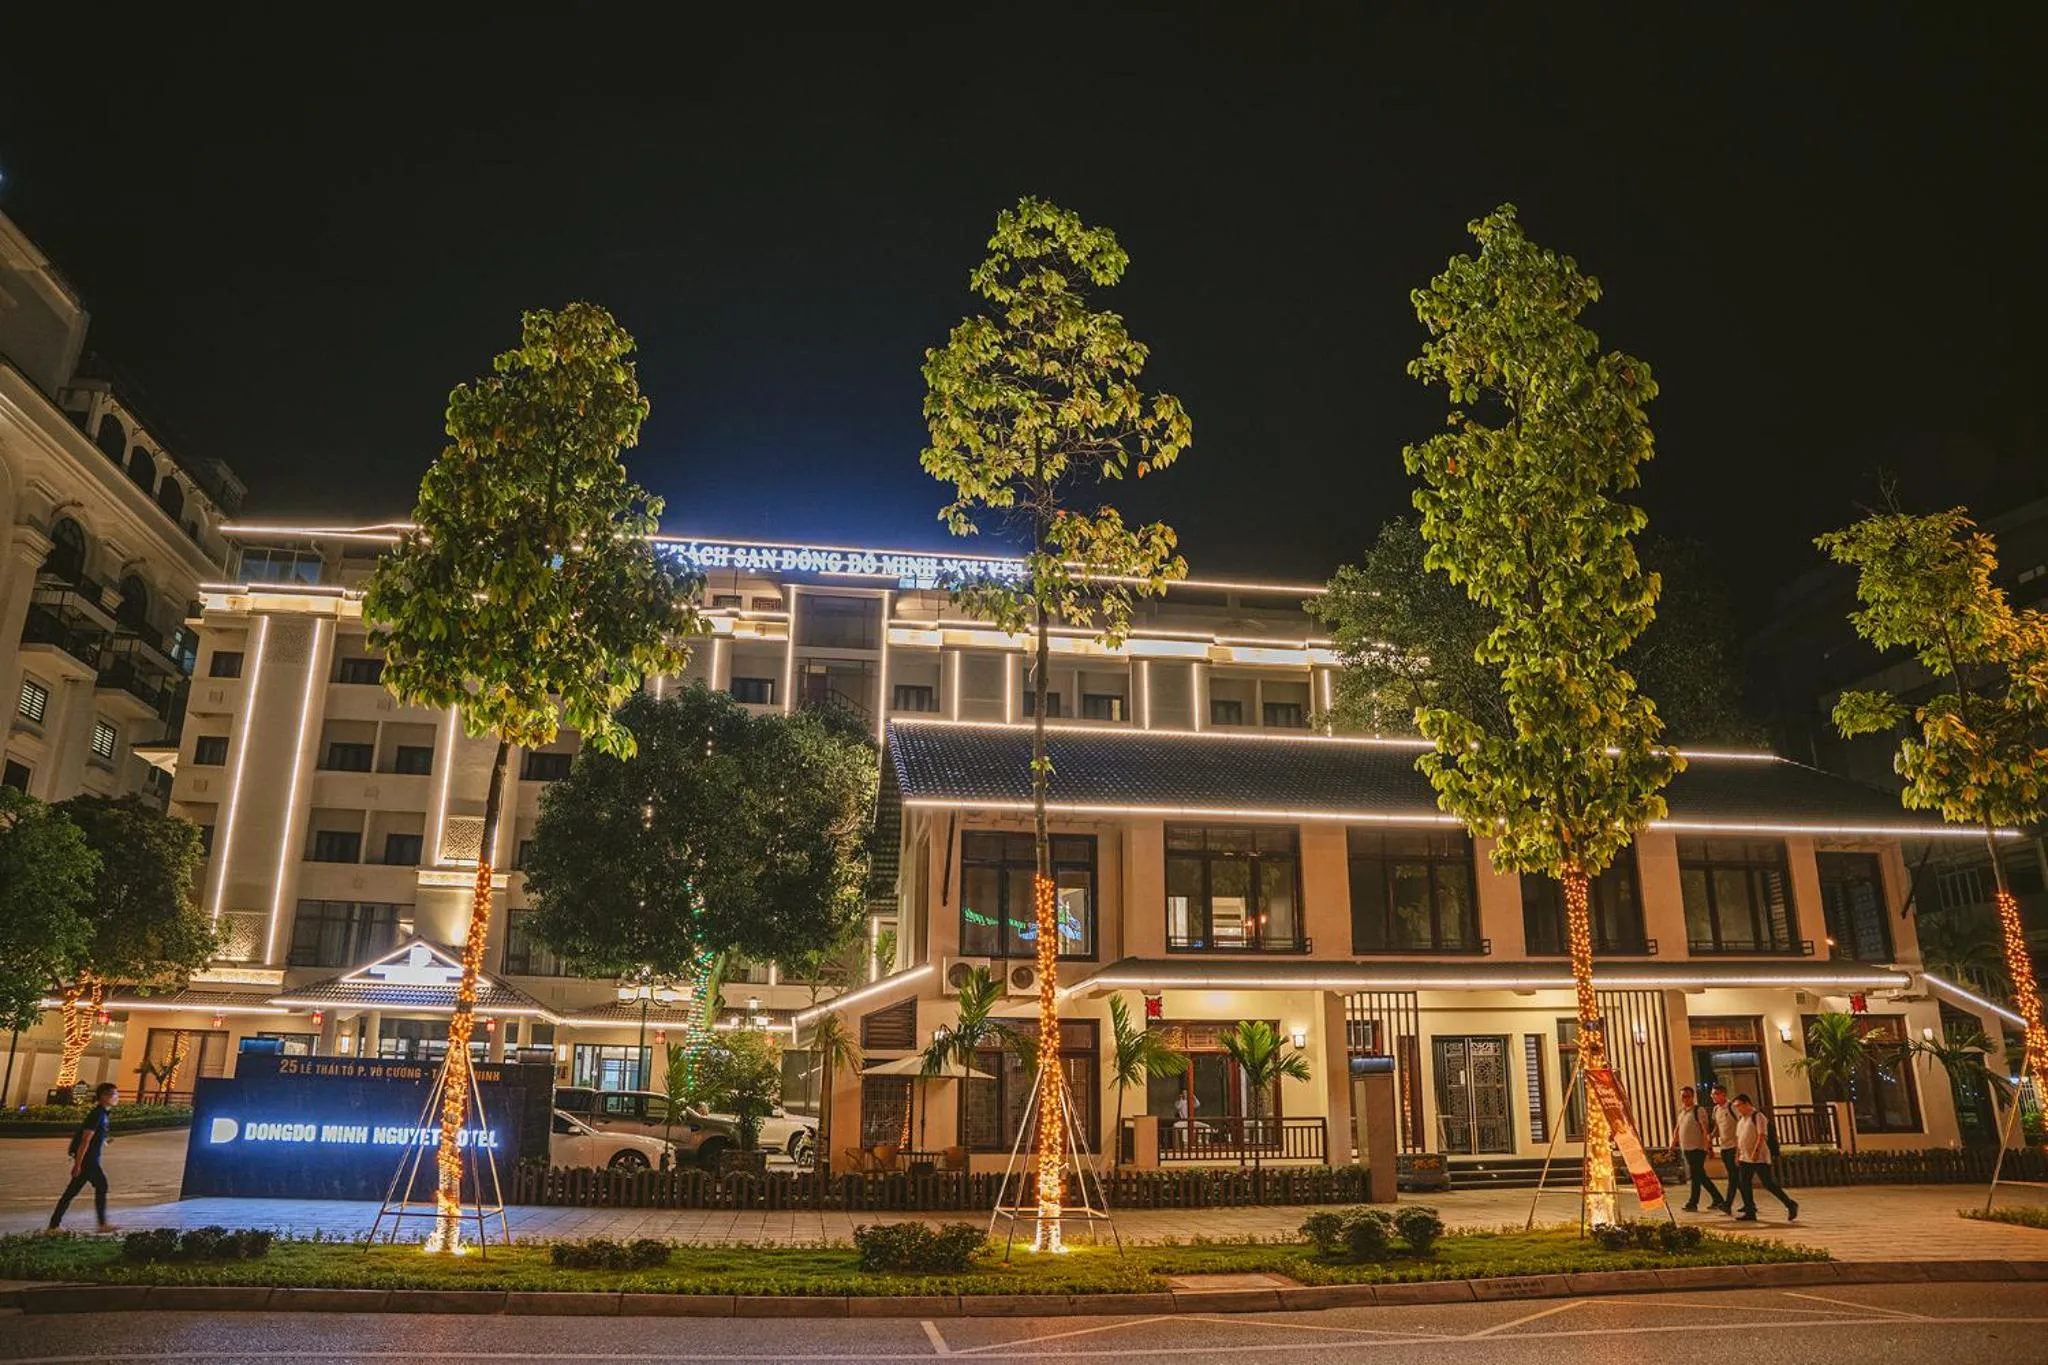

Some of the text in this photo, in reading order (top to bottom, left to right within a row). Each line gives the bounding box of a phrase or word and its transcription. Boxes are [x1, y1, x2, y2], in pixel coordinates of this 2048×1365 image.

[280, 1059, 298, 1074] 25
[244, 1122, 317, 1143] DONGDO
[320, 1125, 369, 1144] MINH
[372, 1126, 441, 1146] NGUYET
[448, 1128, 498, 1148] OTEL
